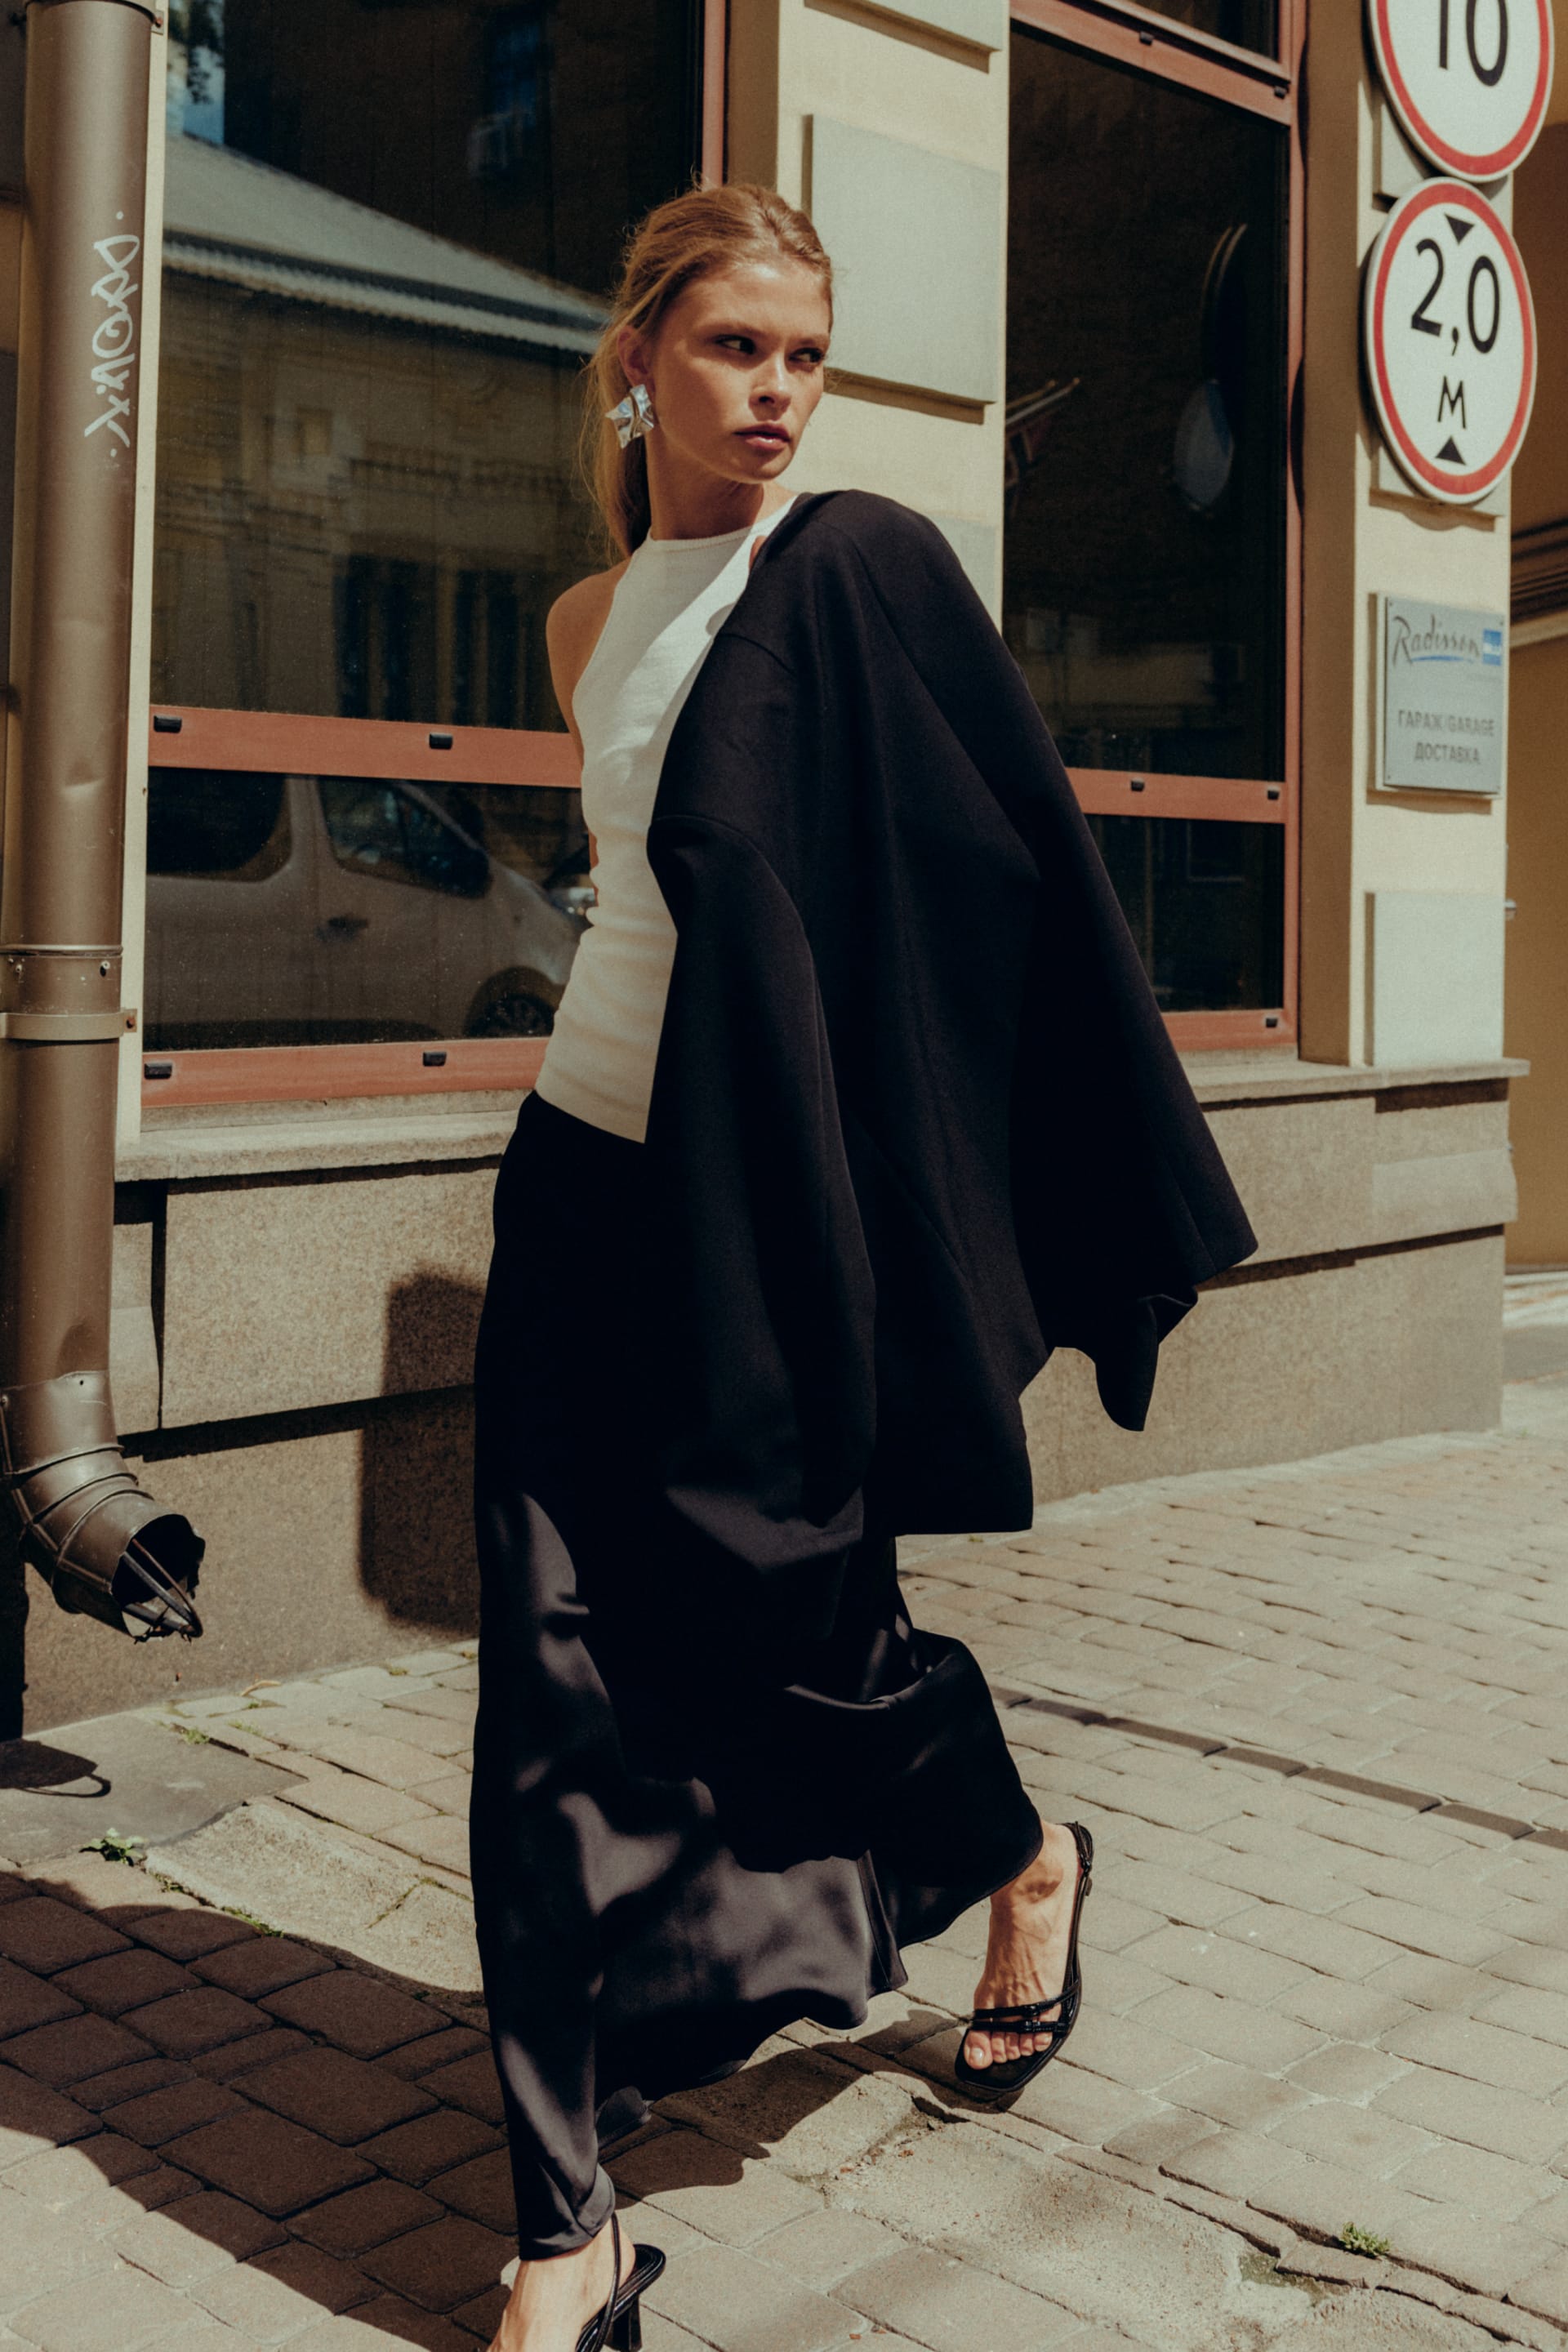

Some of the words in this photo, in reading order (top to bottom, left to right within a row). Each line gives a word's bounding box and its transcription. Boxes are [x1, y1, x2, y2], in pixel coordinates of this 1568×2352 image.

[1438, 0, 1508, 87] 10
[1410, 238, 1500, 354] 2,0
[1414, 742, 1481, 764] ДОСТАВКА
